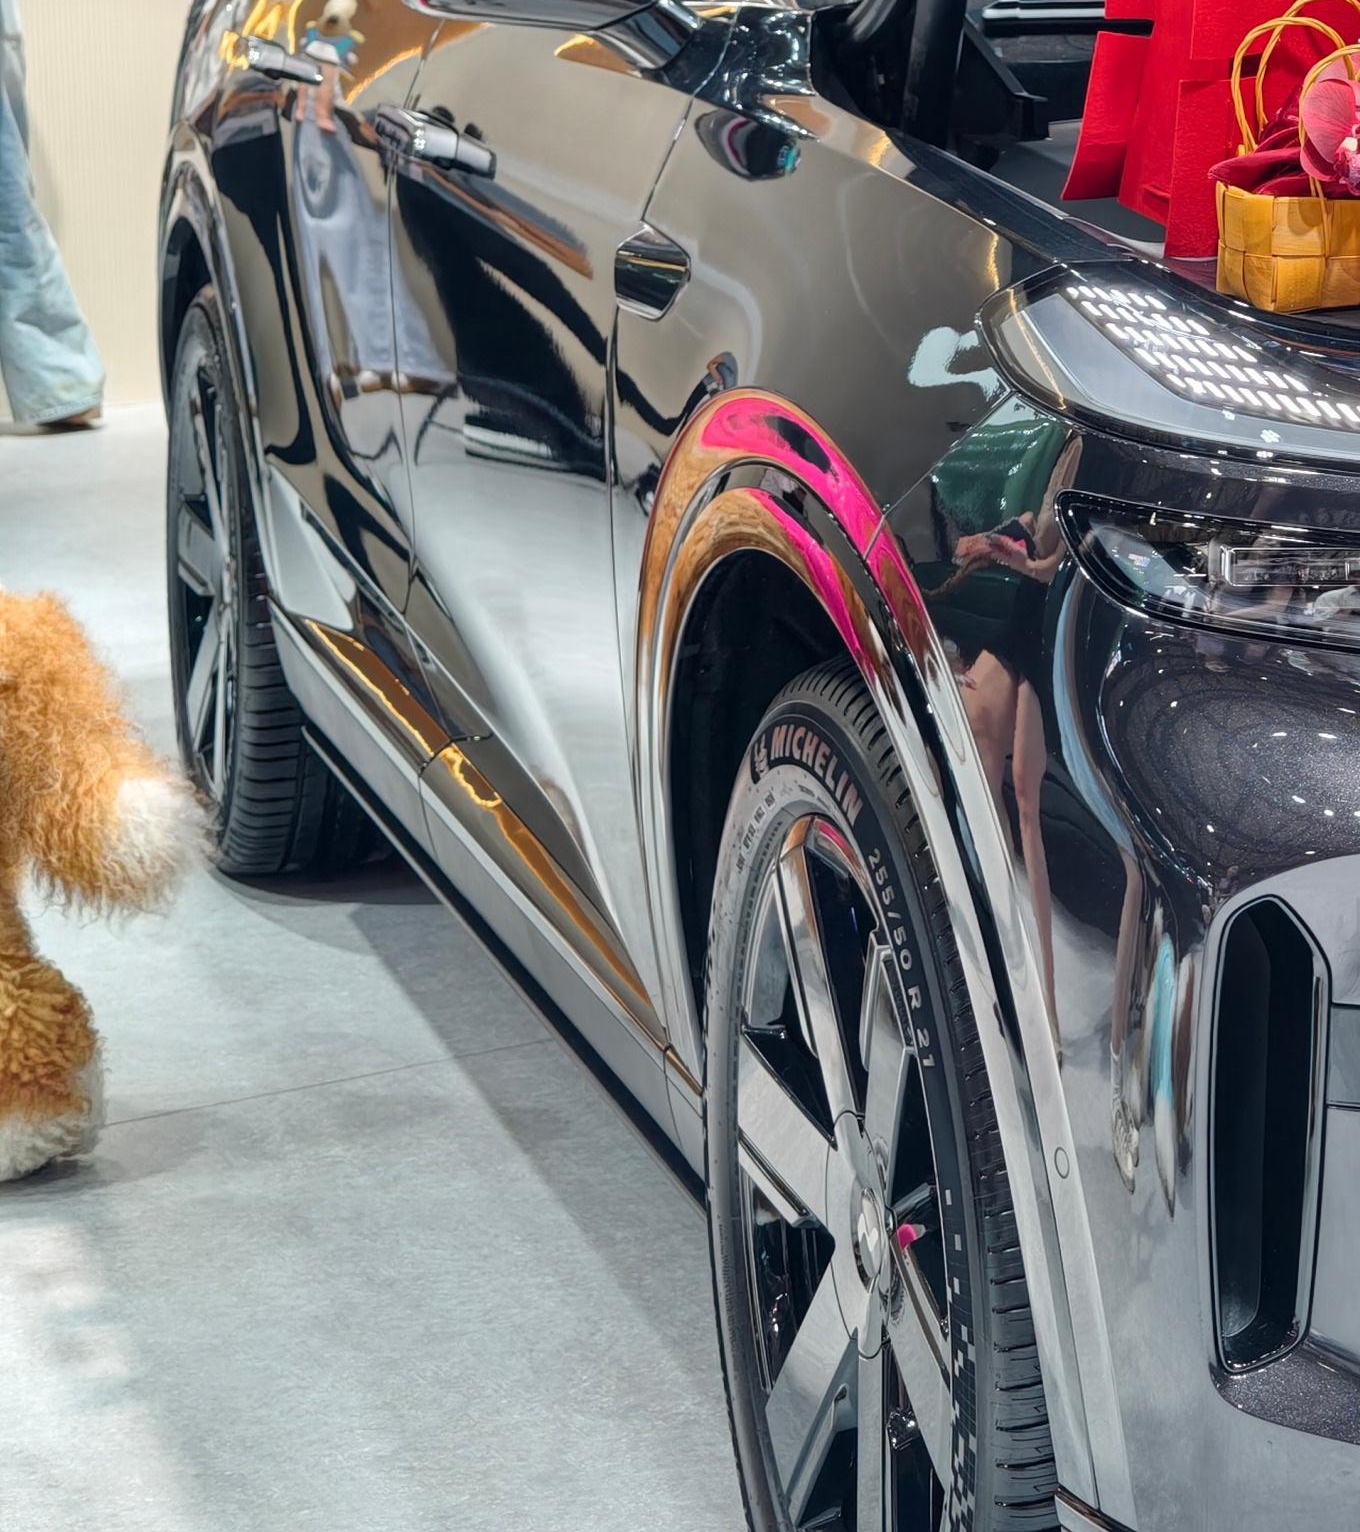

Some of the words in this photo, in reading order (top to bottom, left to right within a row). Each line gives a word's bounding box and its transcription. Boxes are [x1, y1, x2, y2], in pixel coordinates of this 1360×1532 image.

[770, 724, 864, 828] MICHELIN
[868, 848, 913, 971] 255/50
[908, 985, 923, 1010] R
[916, 1028, 936, 1068] 21
